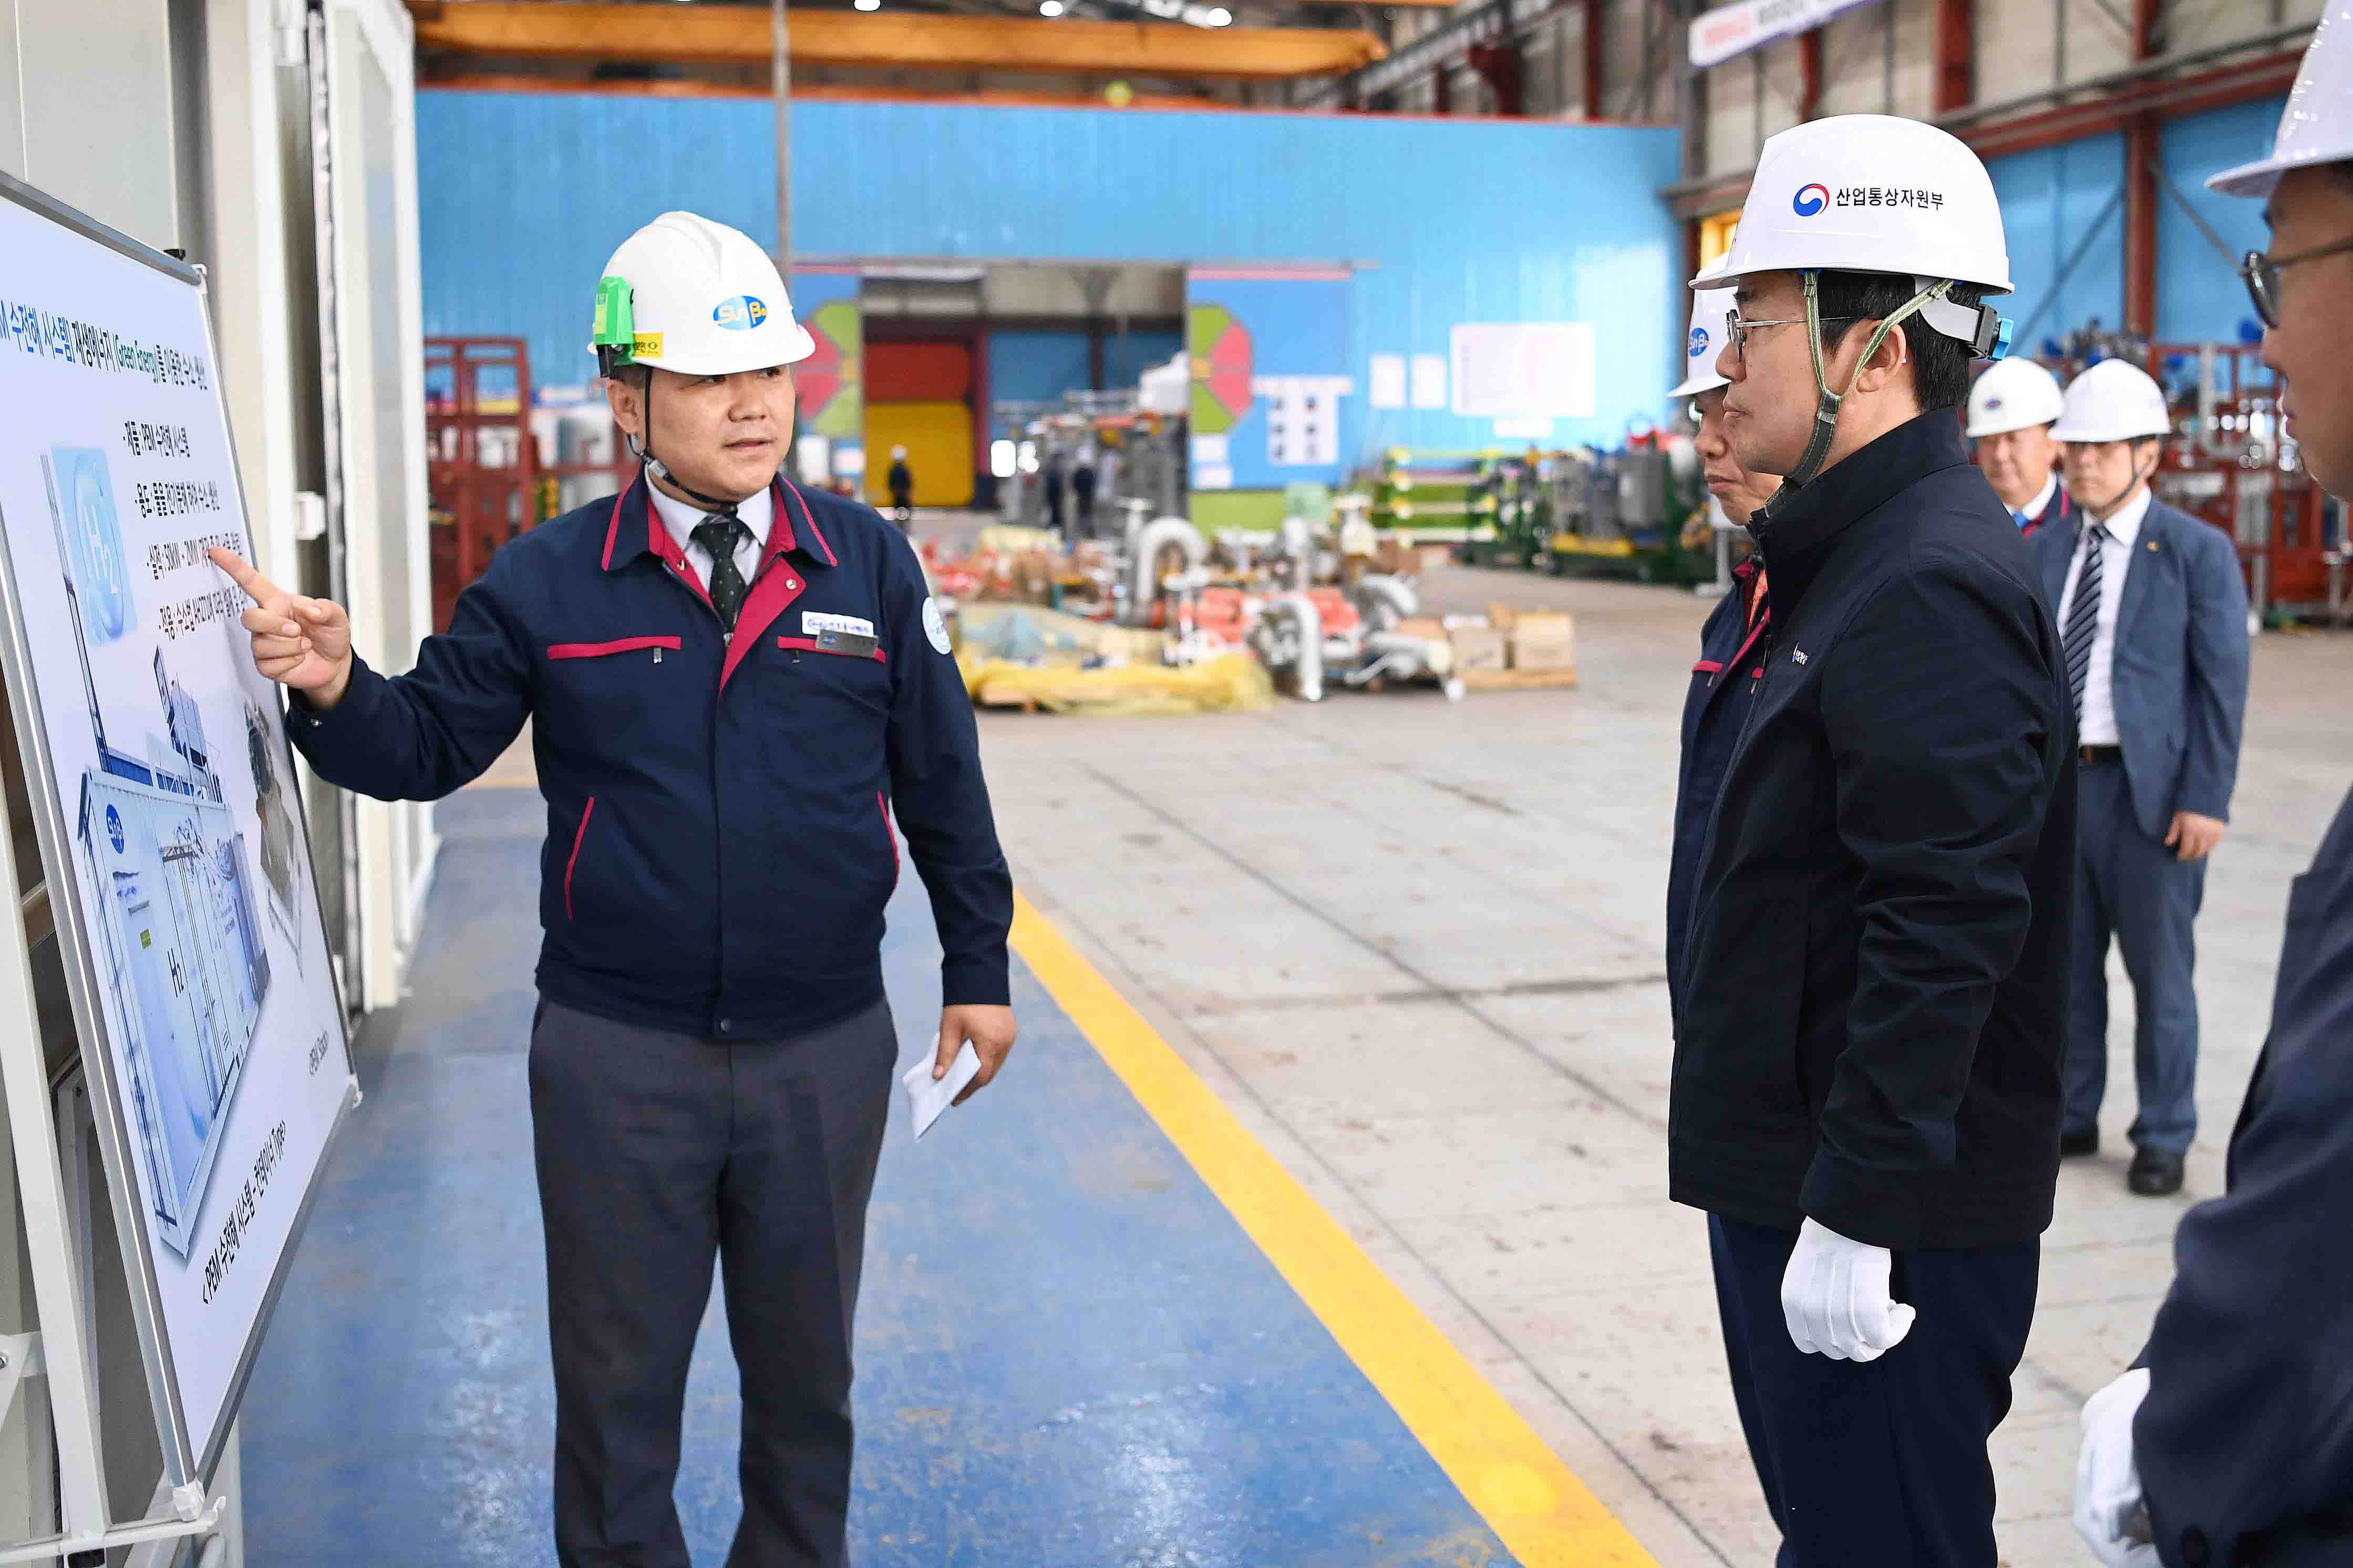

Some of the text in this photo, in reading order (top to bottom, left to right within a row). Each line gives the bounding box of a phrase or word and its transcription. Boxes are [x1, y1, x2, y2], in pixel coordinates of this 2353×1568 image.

[1836, 187, 1944, 211] 산업통상자원부
[11, 301, 44, 357] 수전해
[72, 320, 116, 373] 재생에너지
[141, 423, 157, 451] PEM
[156, 424, 174, 458] 수전해
[153, 482, 168, 516] 물을
[220, 1210, 240, 1275] 수전해
[236, 1178, 255, 1235] 시스템
[254, 1135, 277, 1198] 컨테이너
